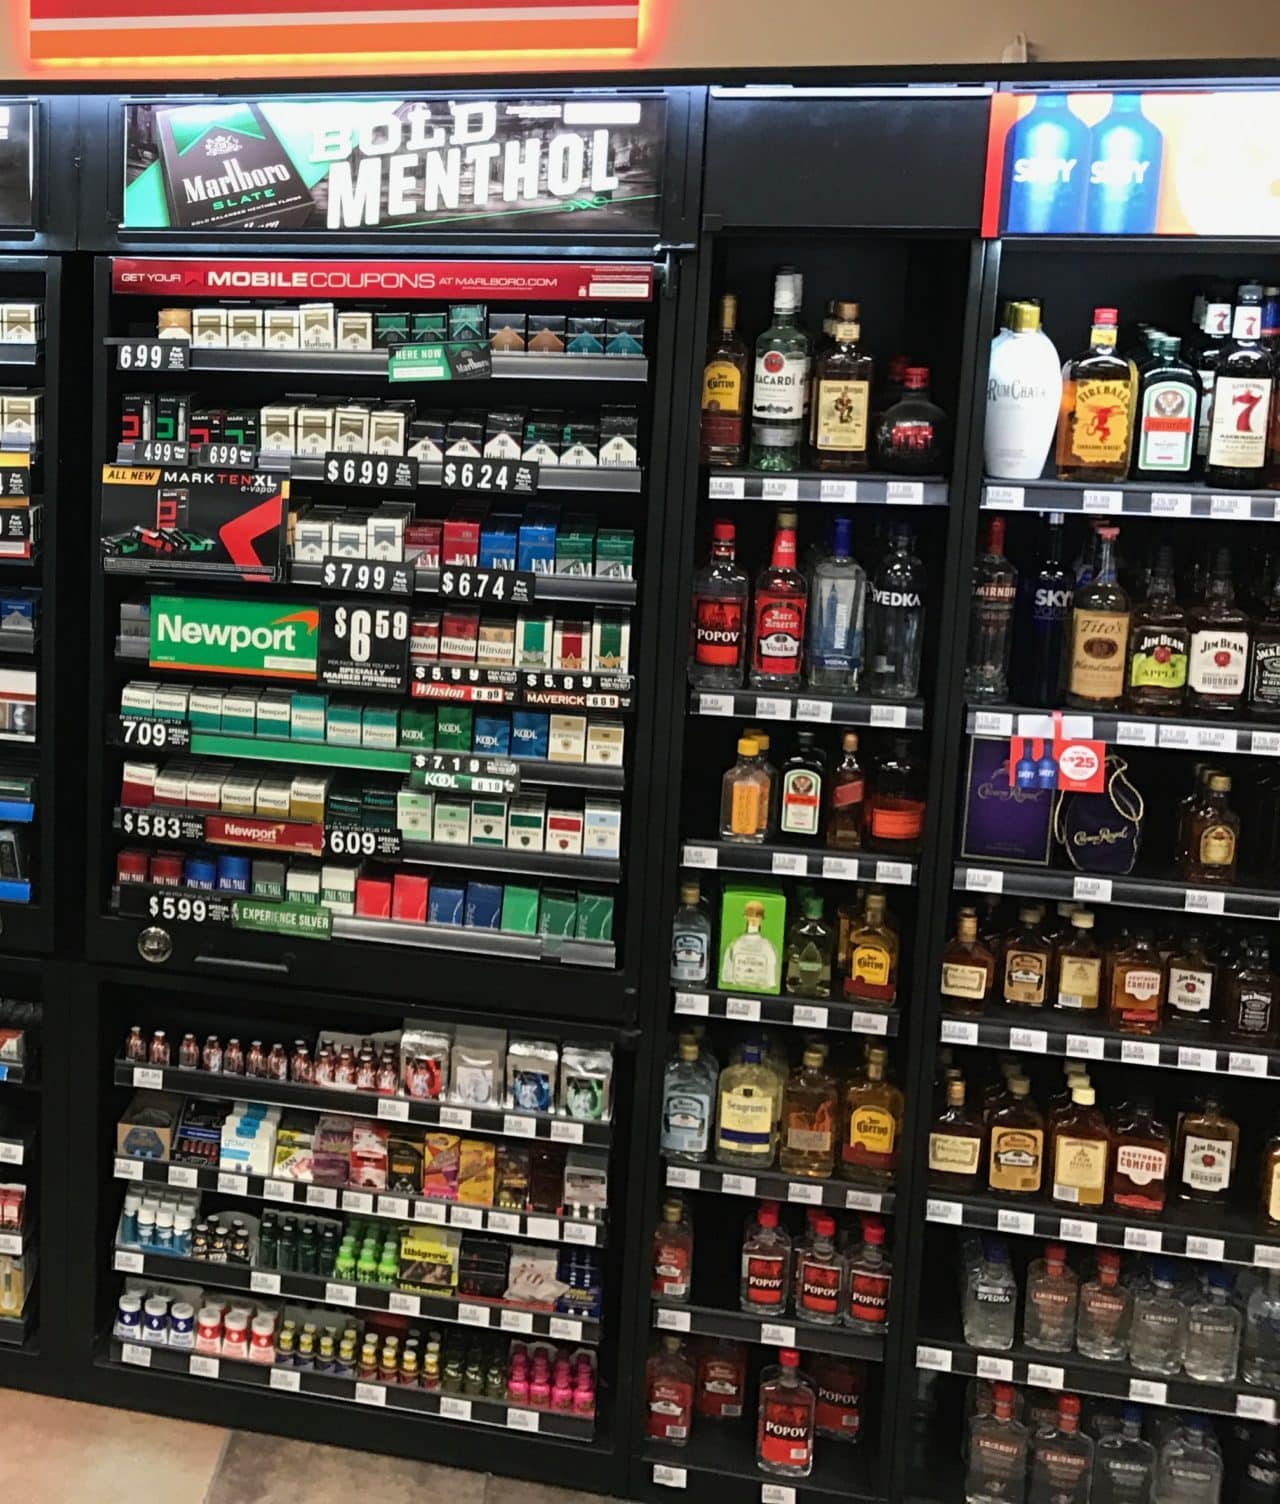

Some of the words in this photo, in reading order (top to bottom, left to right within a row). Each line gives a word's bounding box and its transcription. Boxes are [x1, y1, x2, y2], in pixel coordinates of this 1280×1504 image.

[308, 101, 496, 162] BOLD
[182, 156, 291, 204] Marlboro
[326, 129, 618, 229] MENTHOL
[212, 189, 276, 211] SLATE
[121, 273, 144, 283] GET
[146, 273, 181, 283] YOUR
[208, 272, 307, 288] MOBILE
[309, 272, 435, 289] COUPONS
[439, 277, 454, 286] AT
[455, 277, 557, 288] MARLBORO.COM
[120, 344, 162, 369] 6.99
[396, 350, 419, 361] HERE
[421, 349, 442, 359] NOW
[1078, 386, 1130, 405] FIREBALL
[1232, 390, 1263, 433] 7
[144, 442, 170, 462] 4.99
[210, 446, 238, 464] 6.99
[108, 470, 127, 480] ALL
[131, 472, 155, 481] NEW
[327, 458, 389, 486] $6.99
[444, 463, 509, 490] $6.24
[241, 486, 277, 495] e-vapor
[324, 562, 385, 591] $7.99
[442, 574, 505, 600] $6.74
[157, 614, 296, 652] Newport
[697, 628, 740, 643] POPOV
[1081, 619, 1122, 635] Tito's
[1141, 636, 1160, 651] JIM
[1161, 634, 1185, 653] BEAM
[1201, 641, 1220, 655] JIM
[1221, 638, 1244, 655] BEAM
[415, 682, 466, 698] Winston
[527, 694, 585, 706] MAVERICK
[122, 721, 167, 747] 7.09
[402, 730, 425, 740] KOOL
[439, 723, 462, 734] KOOL
[514, 728, 537, 740] KOOL
[476, 736, 499, 747] KOOL
[425, 773, 458, 788] KOOL
[123, 813, 181, 838] $5.83
[224, 822, 278, 841] Newport
[149, 896, 207, 922] $5.99
[243, 907, 297, 926] EXPERIENCE
[299, 914, 329, 929] SILVER
[1120, 1157, 1163, 1173] COMFORT
[750, 1276, 782, 1288] POPOV
[804, 1284, 838, 1297] POPOV
[852, 1292, 887, 1307] POPOV
[819, 1388, 860, 1405] POPOV
[765, 1421, 808, 1438] POPOV
